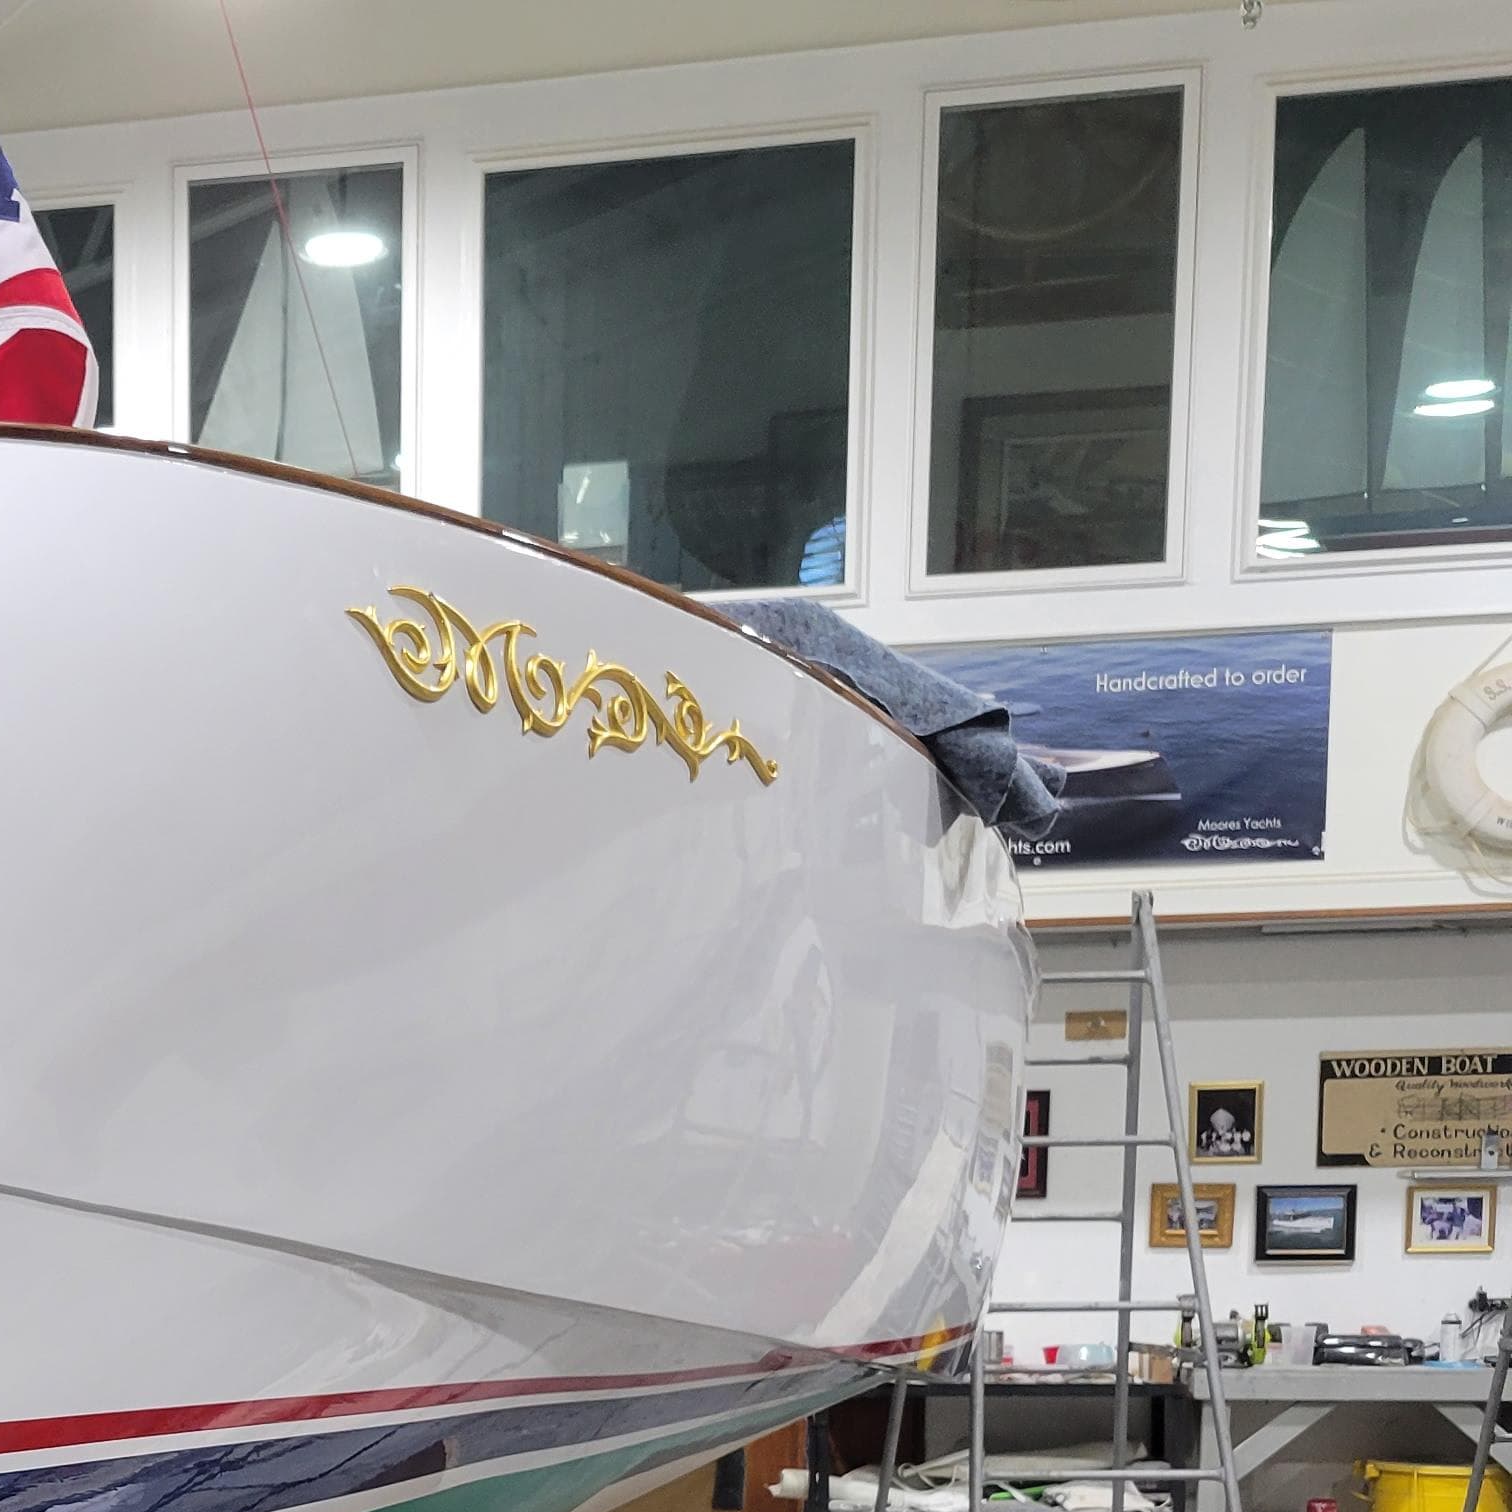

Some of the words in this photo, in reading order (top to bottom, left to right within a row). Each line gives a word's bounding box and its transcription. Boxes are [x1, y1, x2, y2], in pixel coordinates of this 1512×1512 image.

[1095, 667, 1217, 693] Handcrafted
[1224, 667, 1245, 687] to
[1252, 664, 1308, 685] order
[1243, 816, 1282, 831] Yachts
[1331, 1055, 1429, 1078] WOODEN
[1441, 1054, 1498, 1075] BOAT
